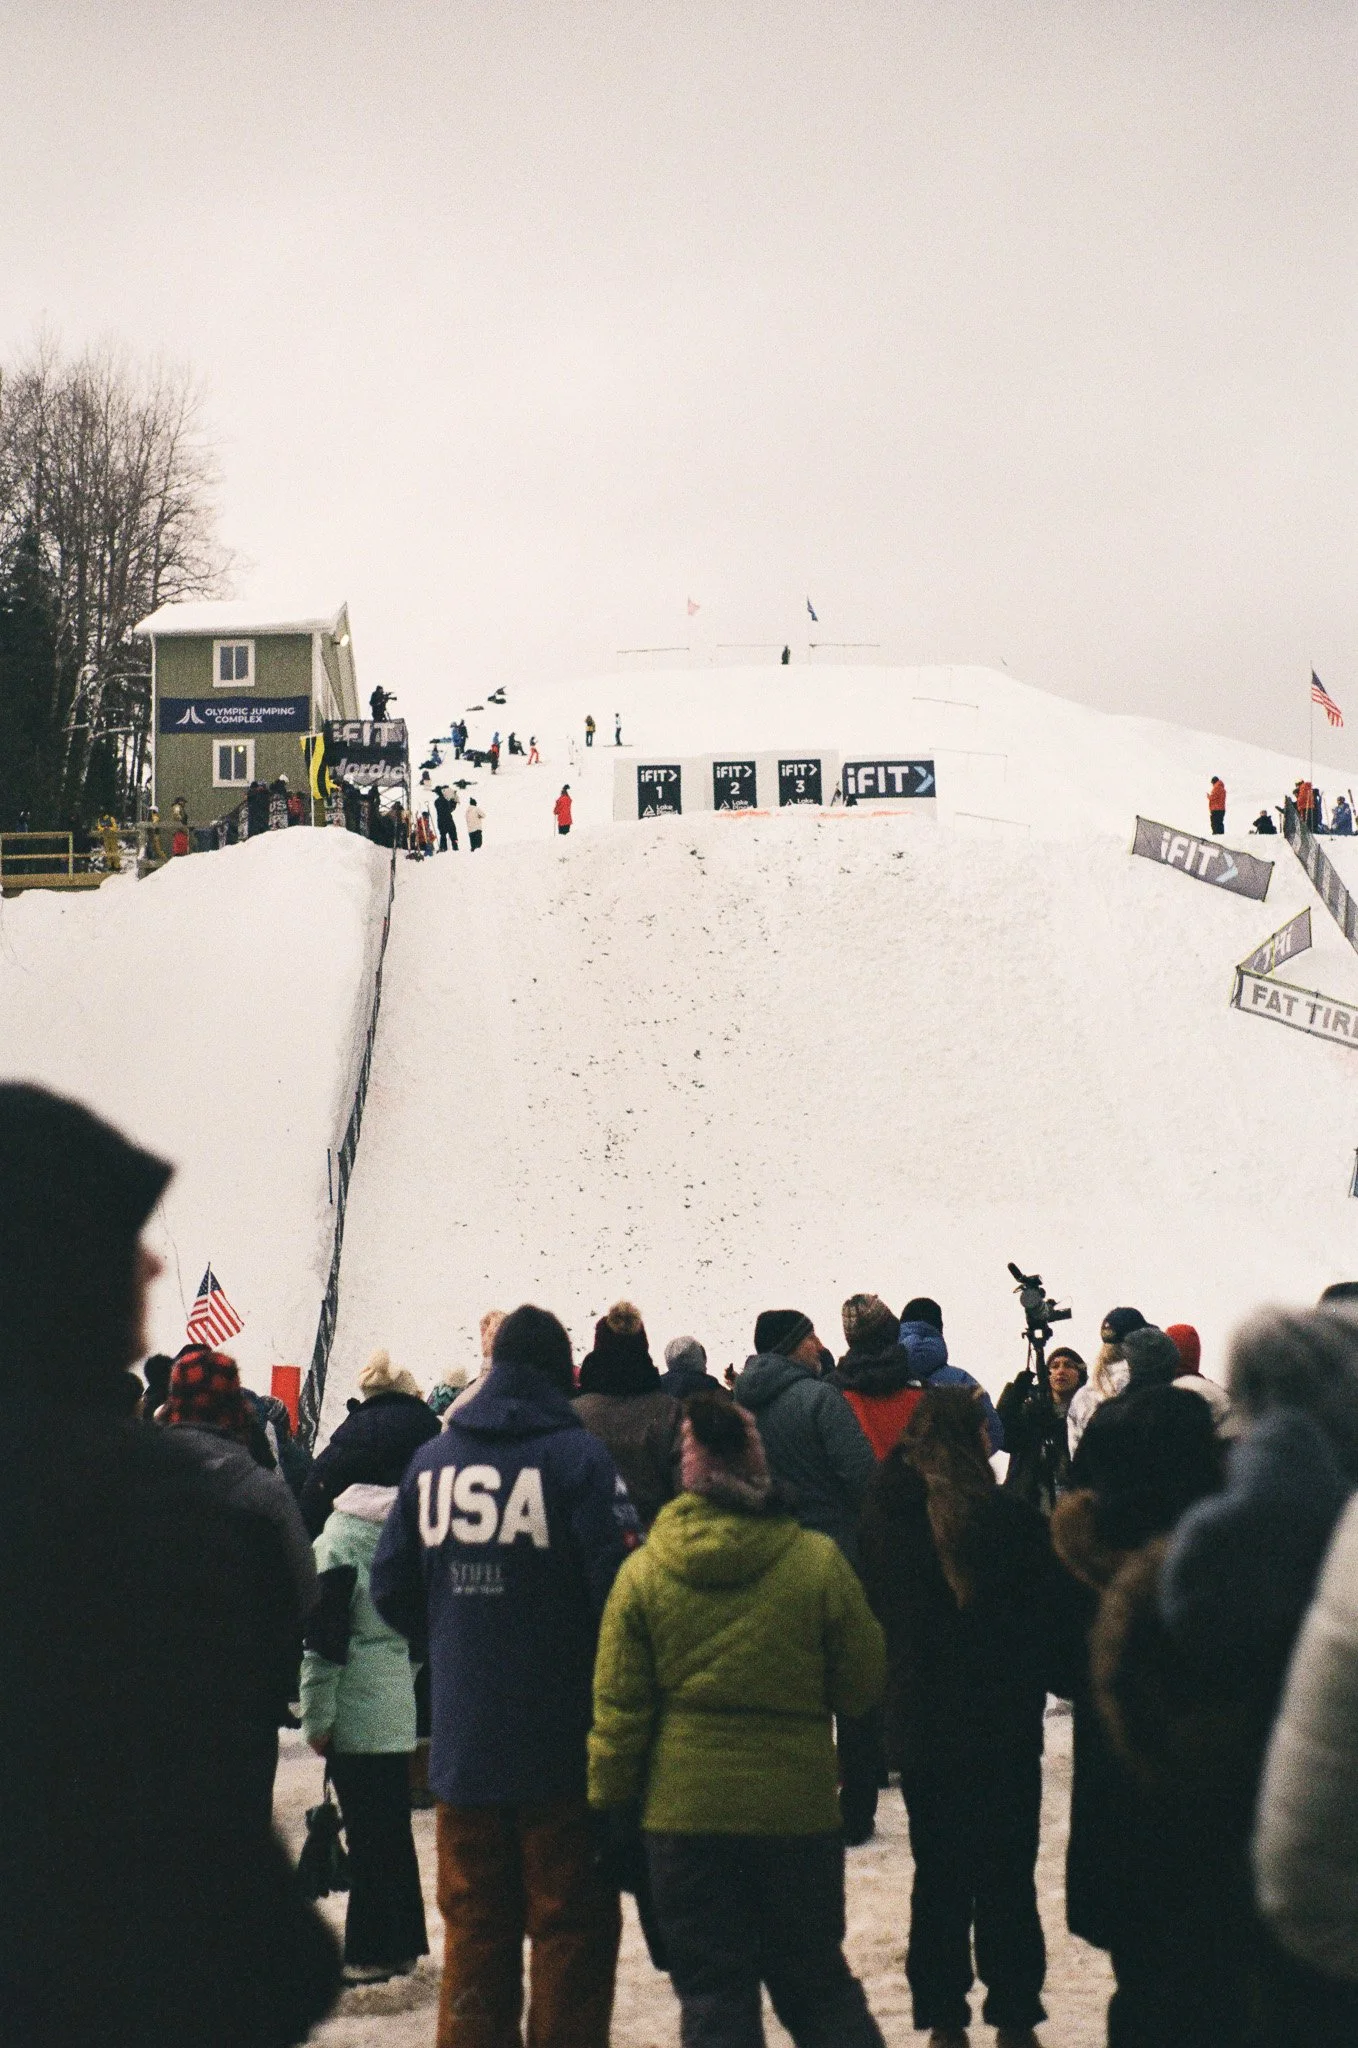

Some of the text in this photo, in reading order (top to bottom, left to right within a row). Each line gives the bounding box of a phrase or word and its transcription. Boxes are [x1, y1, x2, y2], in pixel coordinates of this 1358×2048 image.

[204, 707, 296, 716] OLYMPIC JUMPING
[214, 715, 263, 724] COMPLEX
[640, 769, 668, 783] iFIT
[716, 765, 742, 779] iFIT
[781, 763, 807, 777] iFIT
[795, 780, 805, 793] 3
[847, 765, 909, 795] iFIT
[656, 786, 663, 799] 1
[730, 781, 740, 795] 2
[1161, 831, 1220, 876] iFIT
[1252, 983, 1299, 1017] FAT
[417, 1464, 550, 1548] USA
